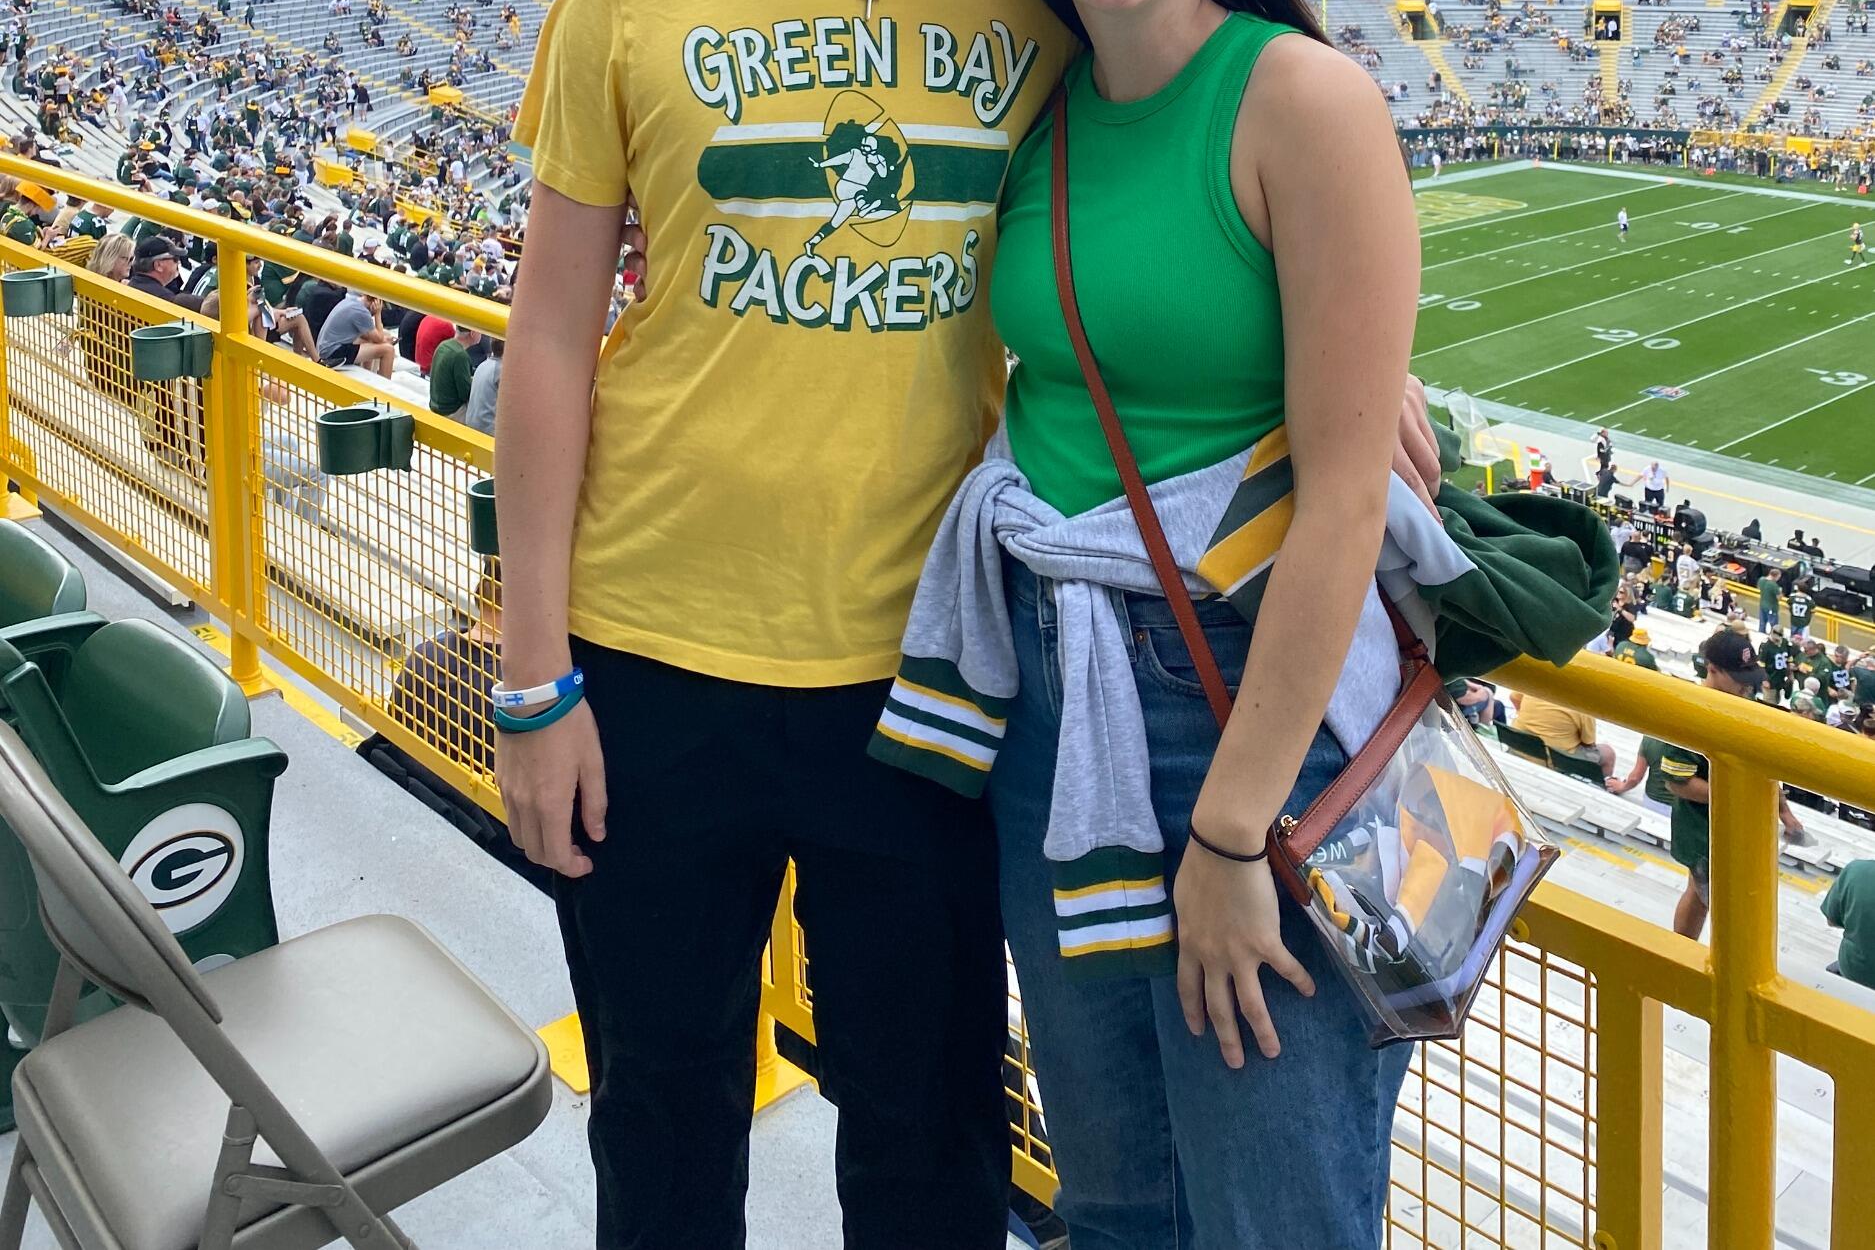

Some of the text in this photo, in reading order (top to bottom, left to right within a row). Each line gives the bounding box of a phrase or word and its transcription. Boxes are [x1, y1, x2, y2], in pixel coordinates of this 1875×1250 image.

[683, 16, 1040, 127] GREEN BAY
[699, 224, 980, 332] PACKERS
[1792, 603, 1808, 617] 87
